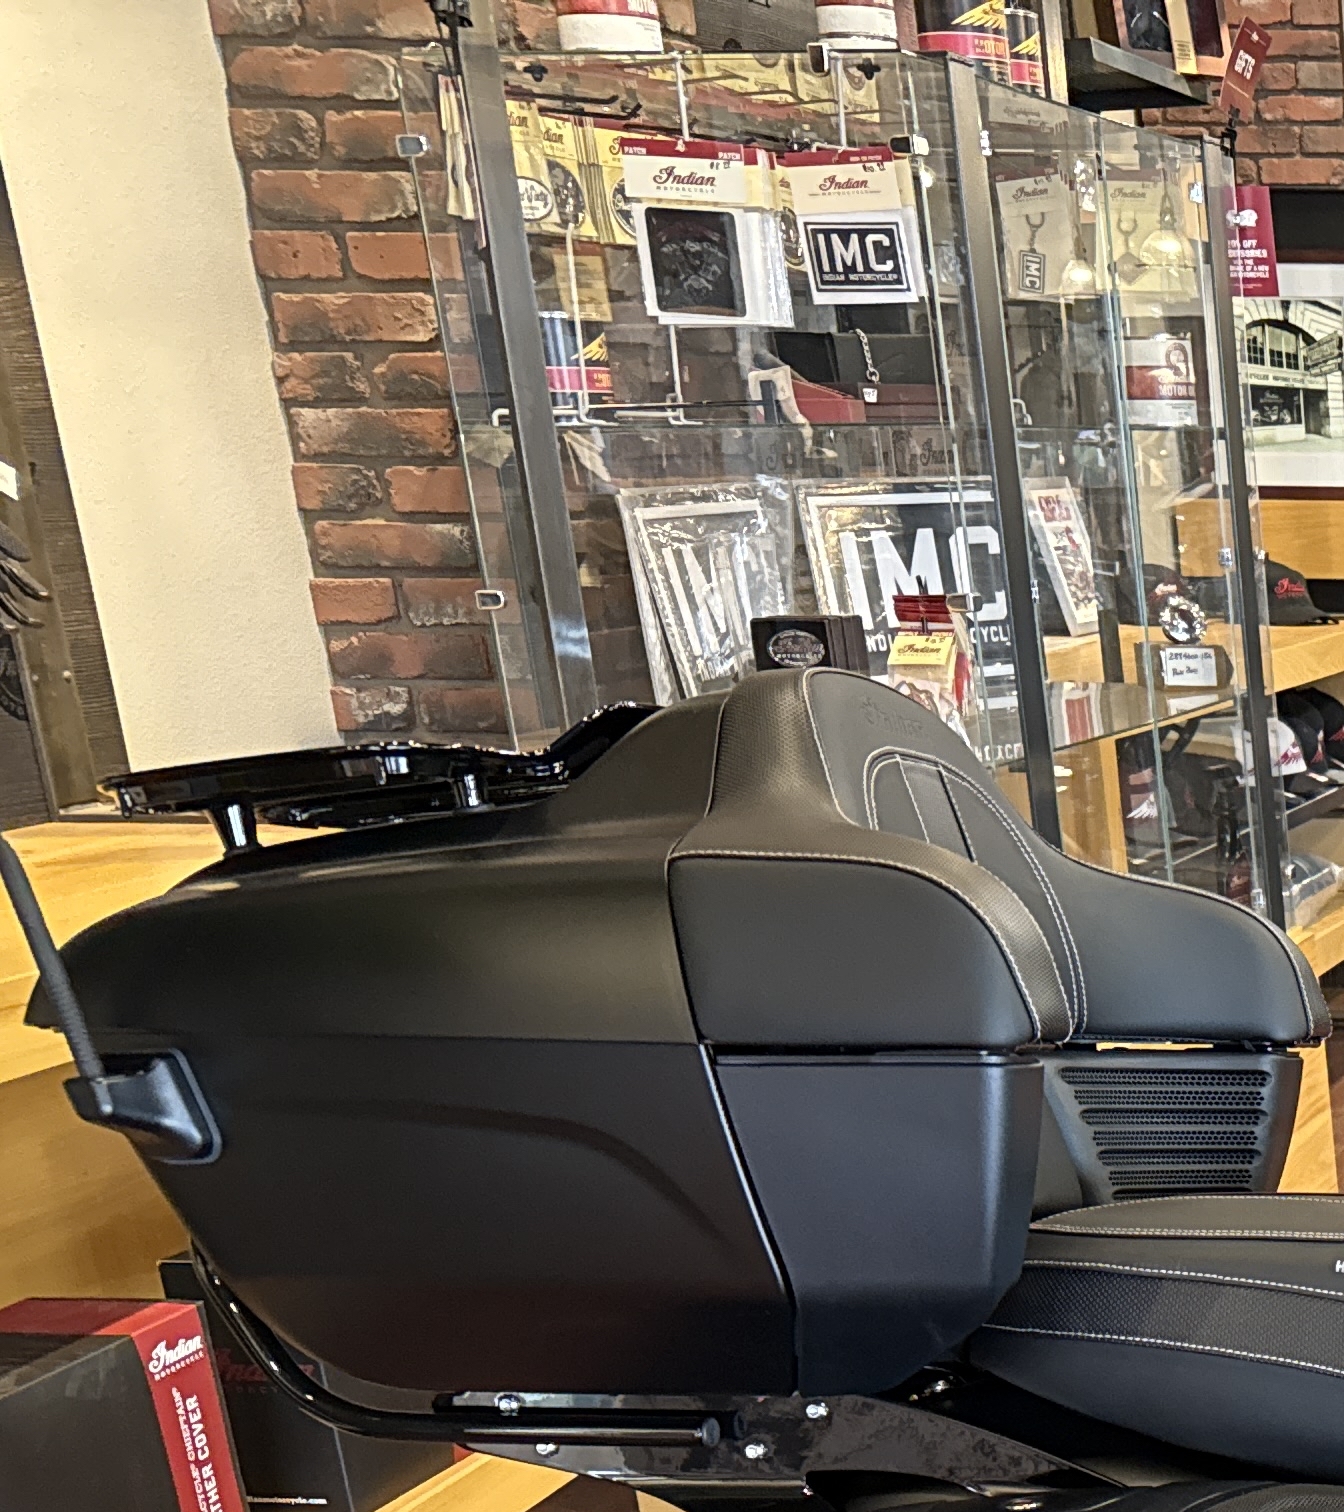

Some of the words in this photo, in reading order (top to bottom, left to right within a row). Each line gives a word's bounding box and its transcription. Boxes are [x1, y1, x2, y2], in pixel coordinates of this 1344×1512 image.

[653, 165, 717, 187] Indian
[819, 174, 870, 191] Indian
[816, 233, 895, 273] IMC
[1025, 257, 1040, 289] IMC
[838, 525, 1008, 631] IMC
[148, 1335, 204, 1374] Indian
[185, 1394, 211, 1461] COVER
